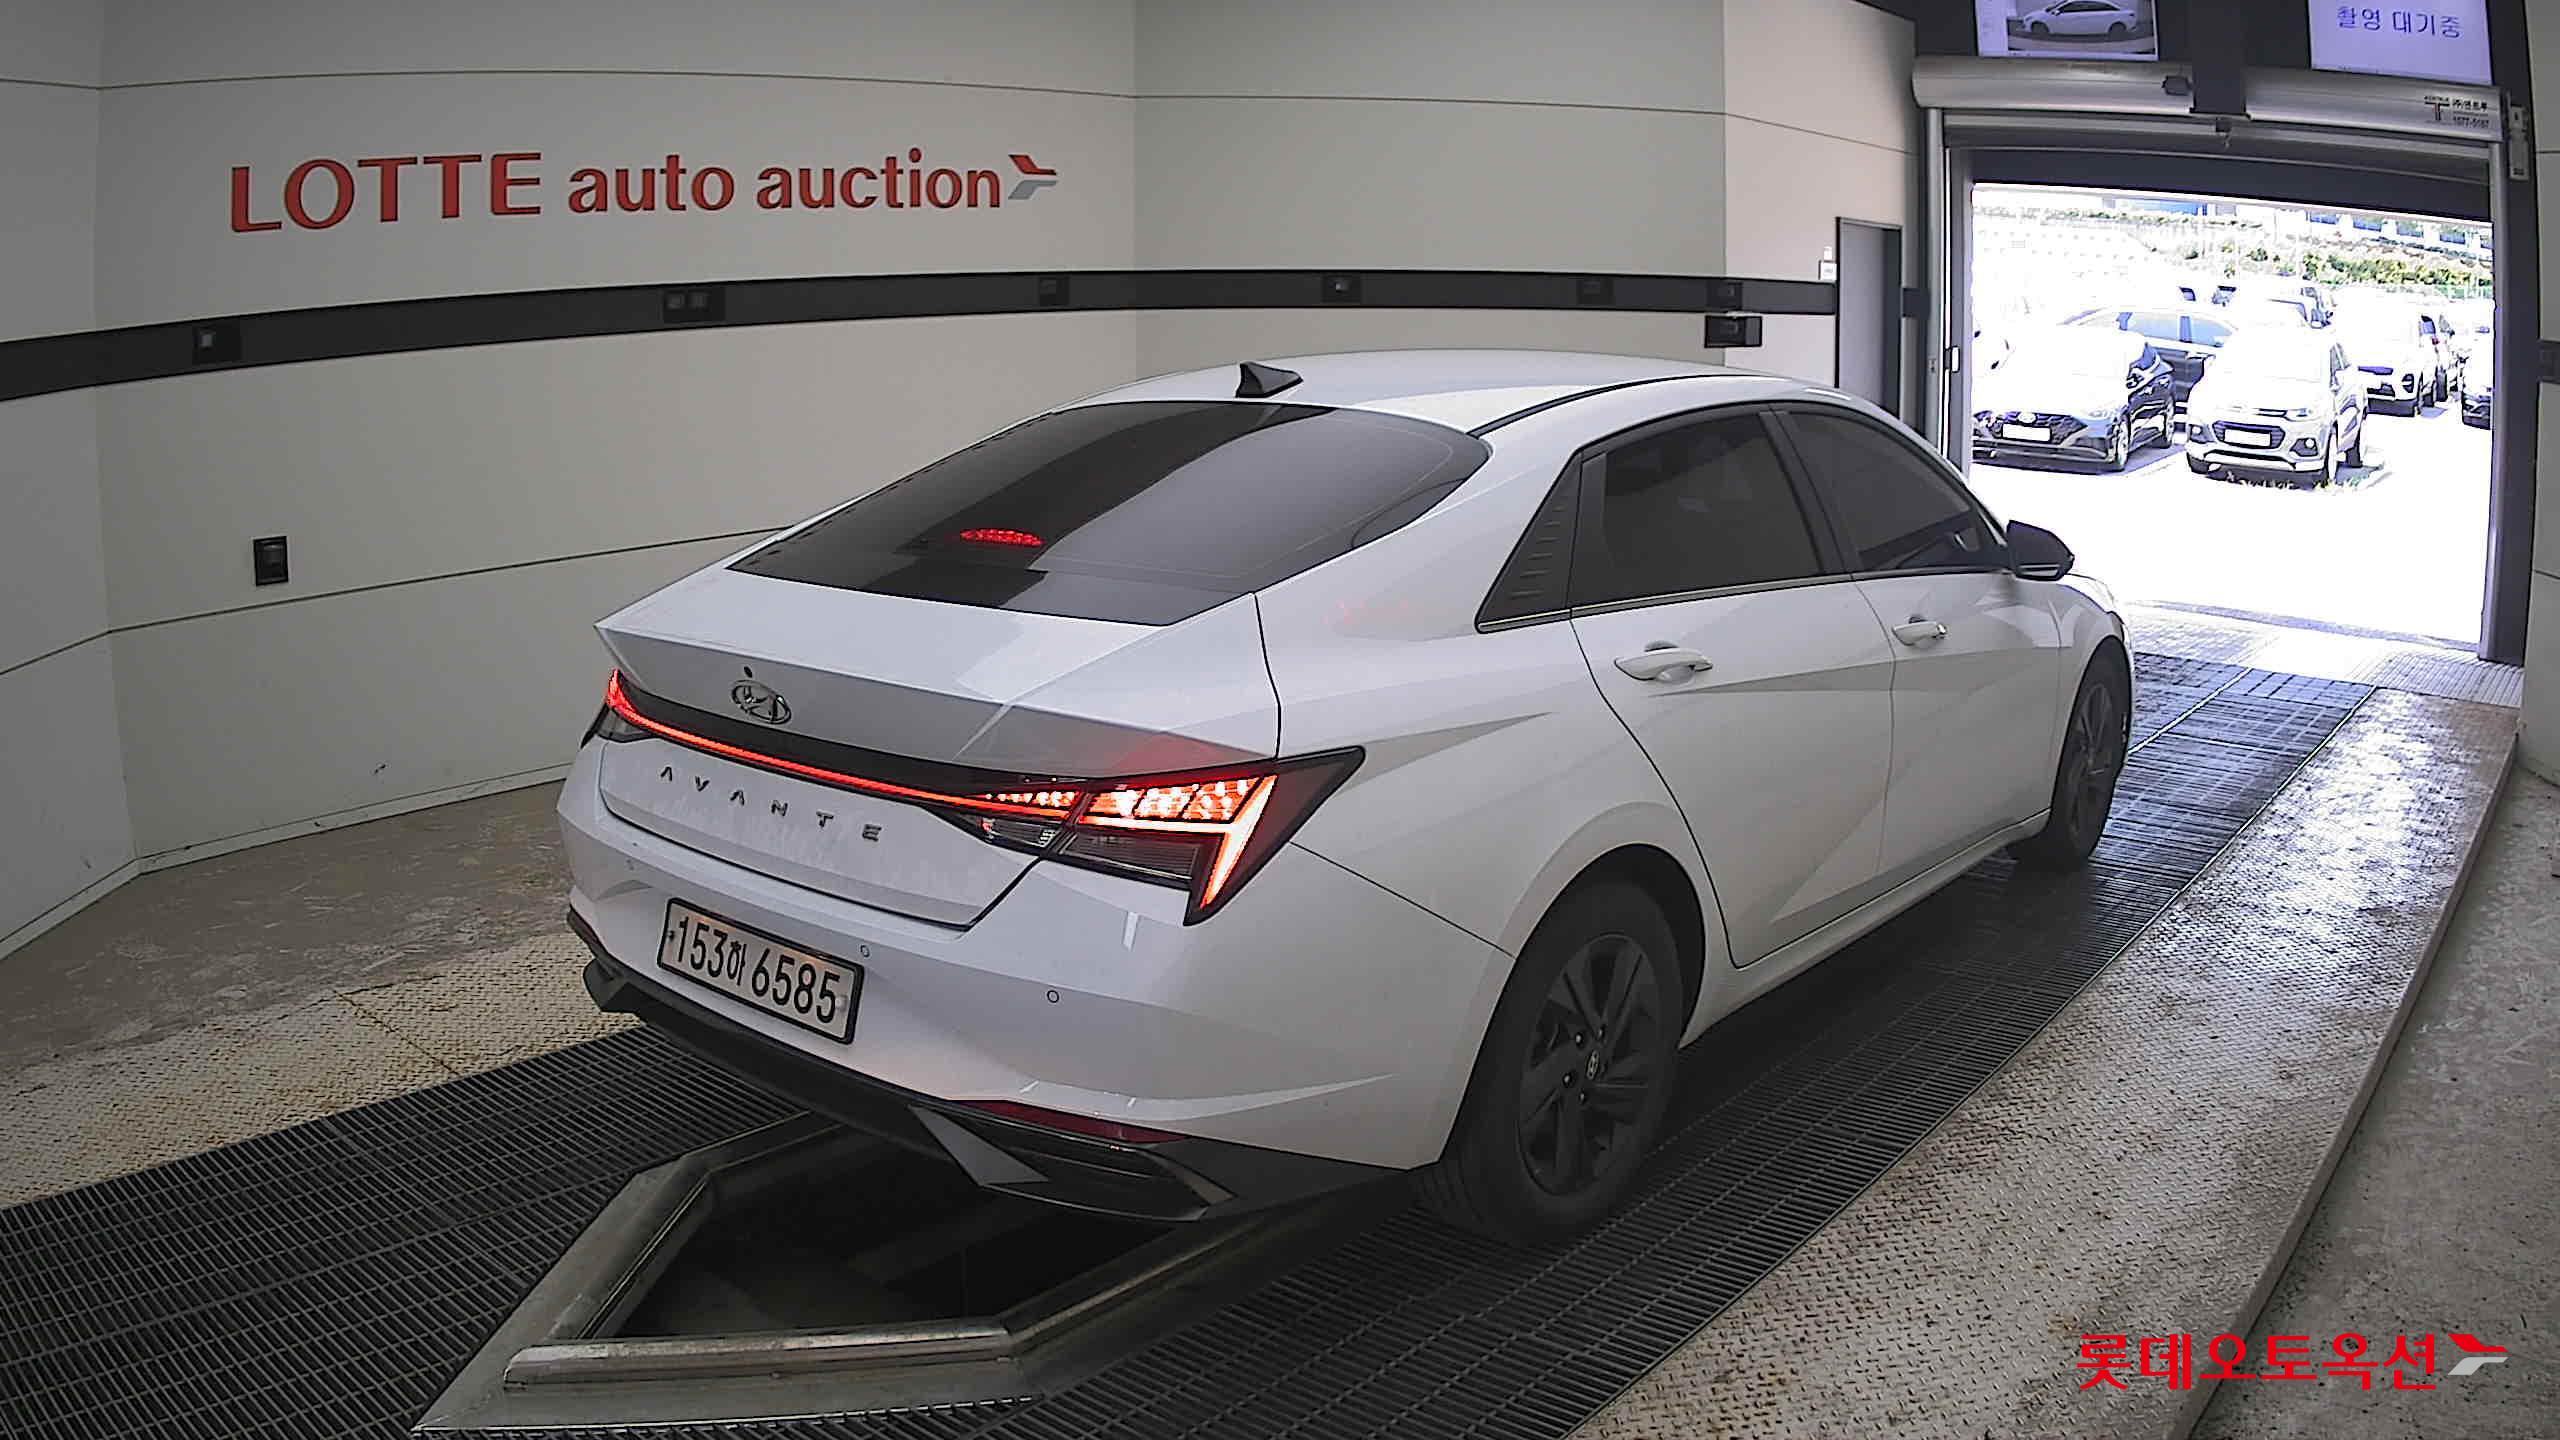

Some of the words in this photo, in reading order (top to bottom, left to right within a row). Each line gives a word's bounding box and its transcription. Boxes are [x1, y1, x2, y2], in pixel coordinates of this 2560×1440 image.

[2338, 6, 2381, 31] 촬영
[2392, 11, 2460, 38] 대기중
[230, 152, 541, 233] LOTTE
[568, 154, 735, 212] auto
[757, 147, 1001, 209] auction
[660, 766, 882, 841] AVANTE
[678, 915, 747, 986] 153하
[751, 948, 841, 1024] 6585
